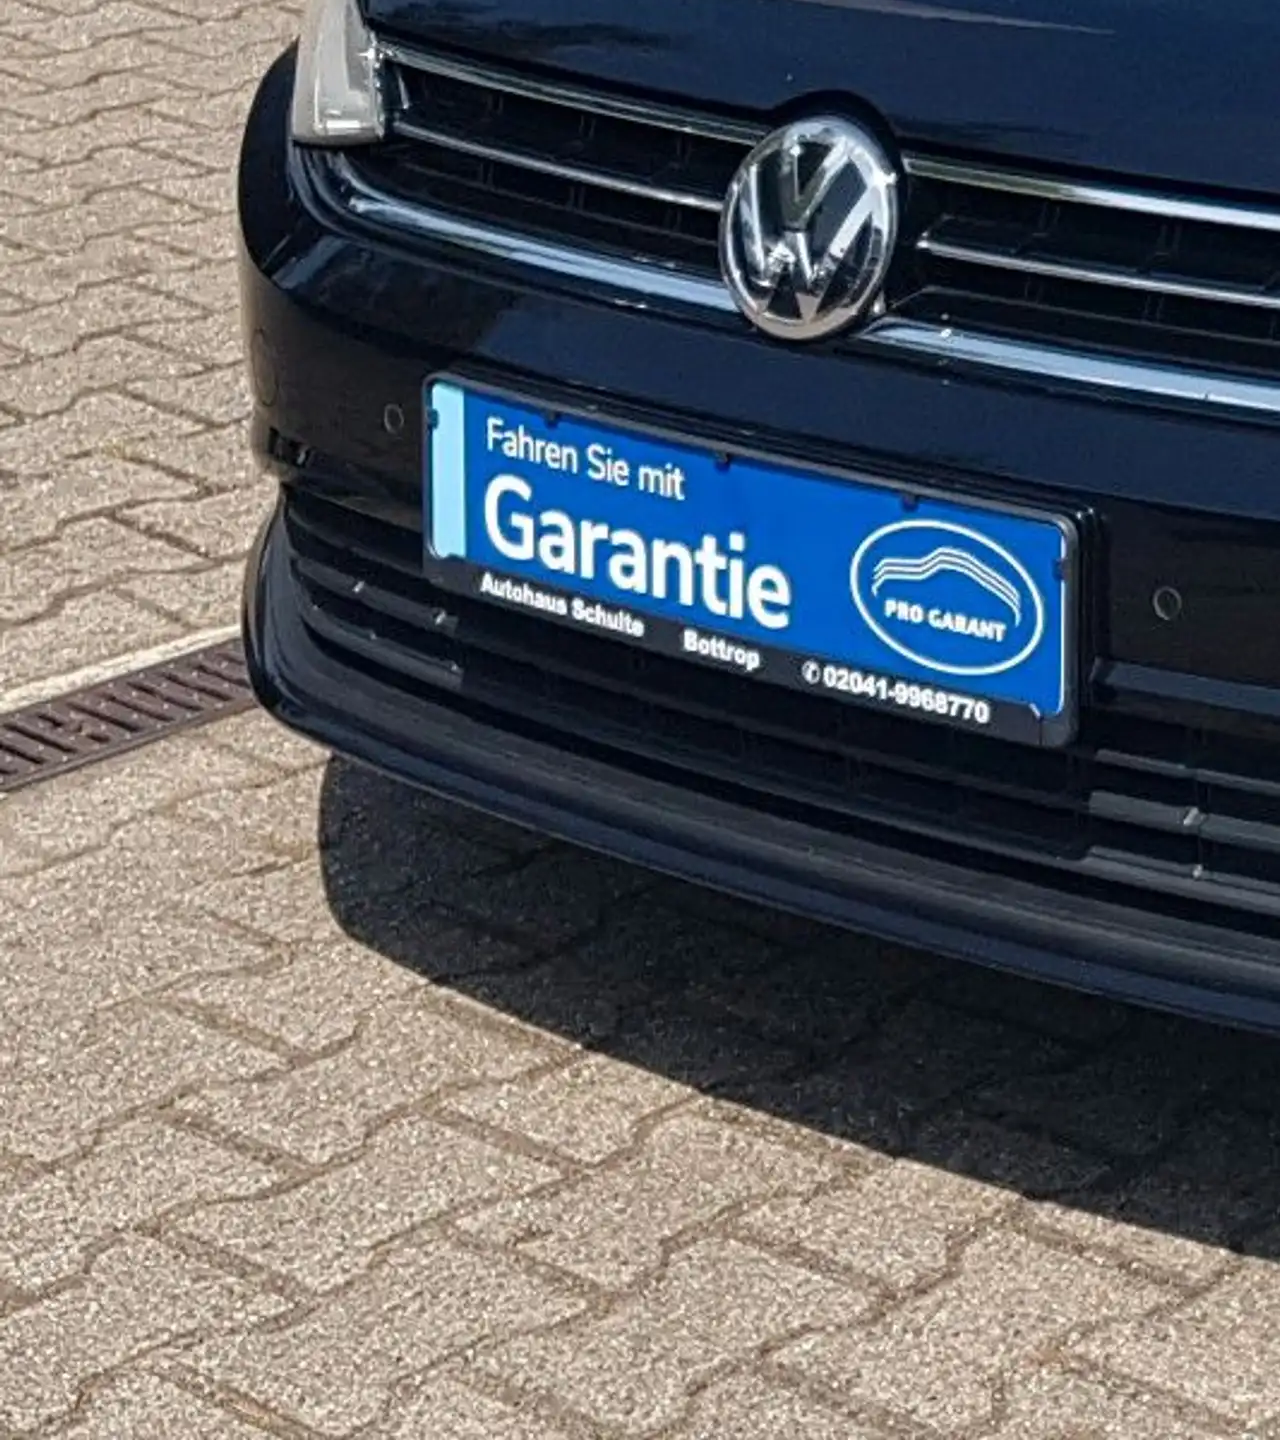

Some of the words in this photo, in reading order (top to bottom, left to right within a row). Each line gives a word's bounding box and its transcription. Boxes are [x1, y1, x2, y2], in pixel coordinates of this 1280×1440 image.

[486, 416, 578, 474] Fahren
[586, 442, 630, 487] Sie
[638, 462, 686, 501] mit
[484, 473, 792, 629] Garantie
[480, 572, 567, 616] Autohaus
[571, 597, 645, 637] Schulte
[683, 628, 760, 671] Bottrop
[884, 598, 923, 624] PRO
[928, 609, 1007, 642] GARANT
